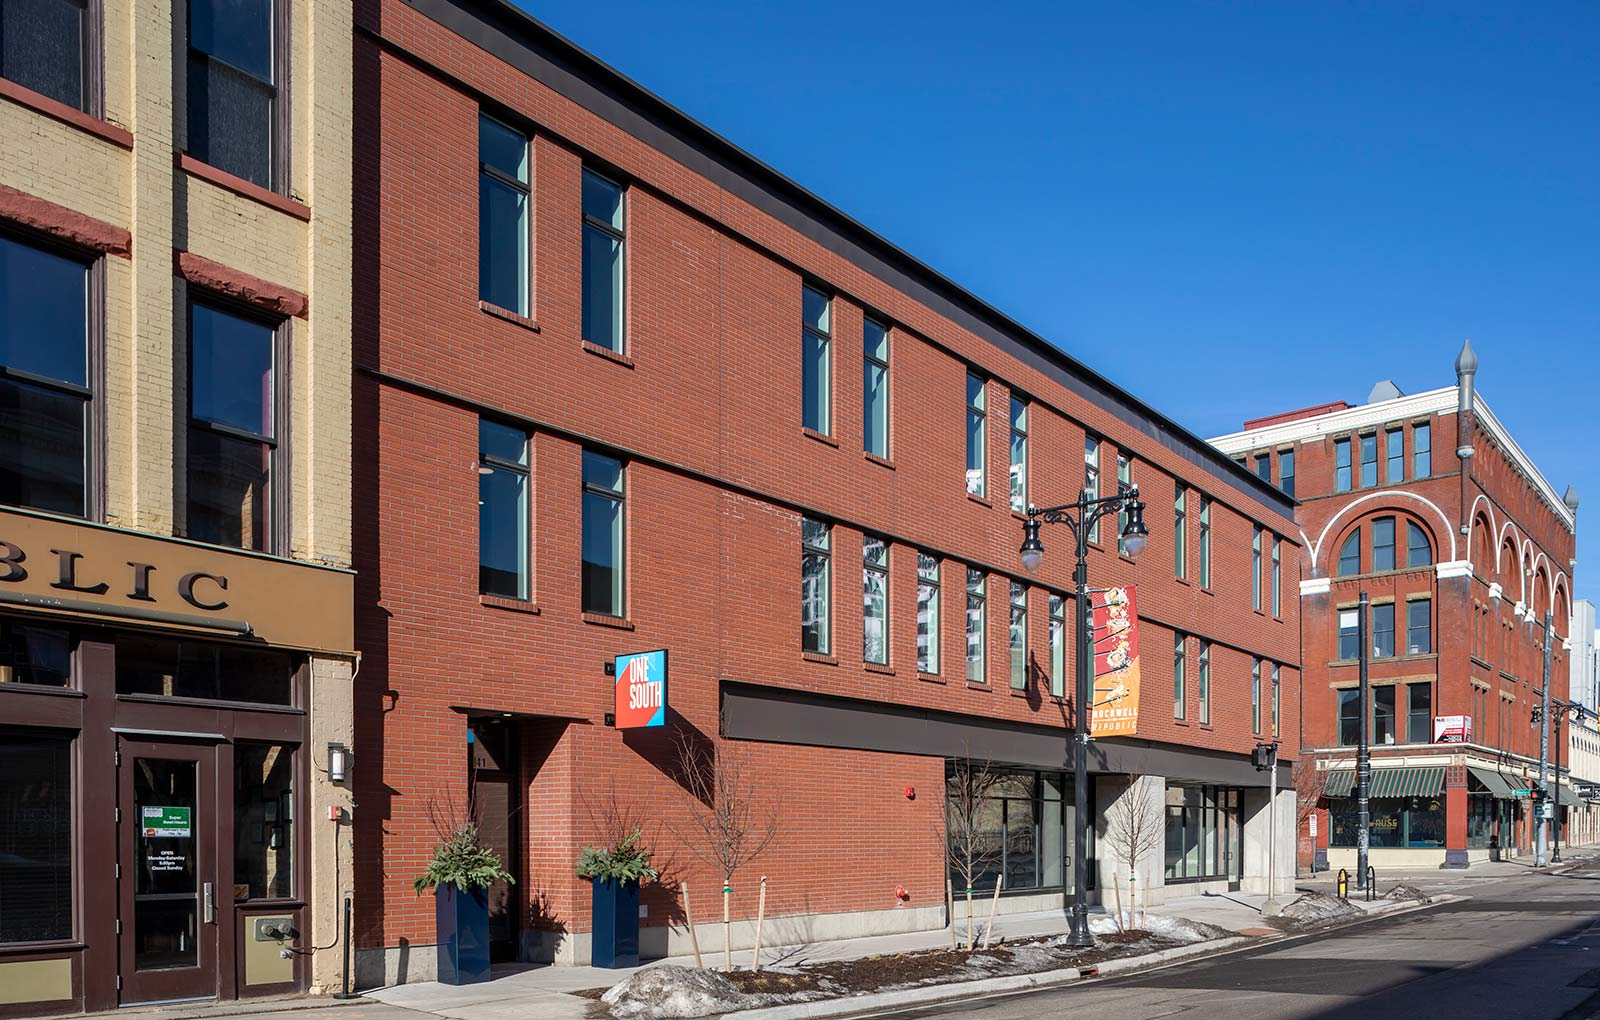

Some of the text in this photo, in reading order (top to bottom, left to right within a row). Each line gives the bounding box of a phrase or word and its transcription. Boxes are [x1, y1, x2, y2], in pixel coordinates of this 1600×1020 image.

[630, 656, 649, 682] ONE
[630, 682, 661, 709] SOUTH
[1093, 708, 1137, 718] ROCKWELL
[1091, 720, 1136, 732] REPUBLIC
